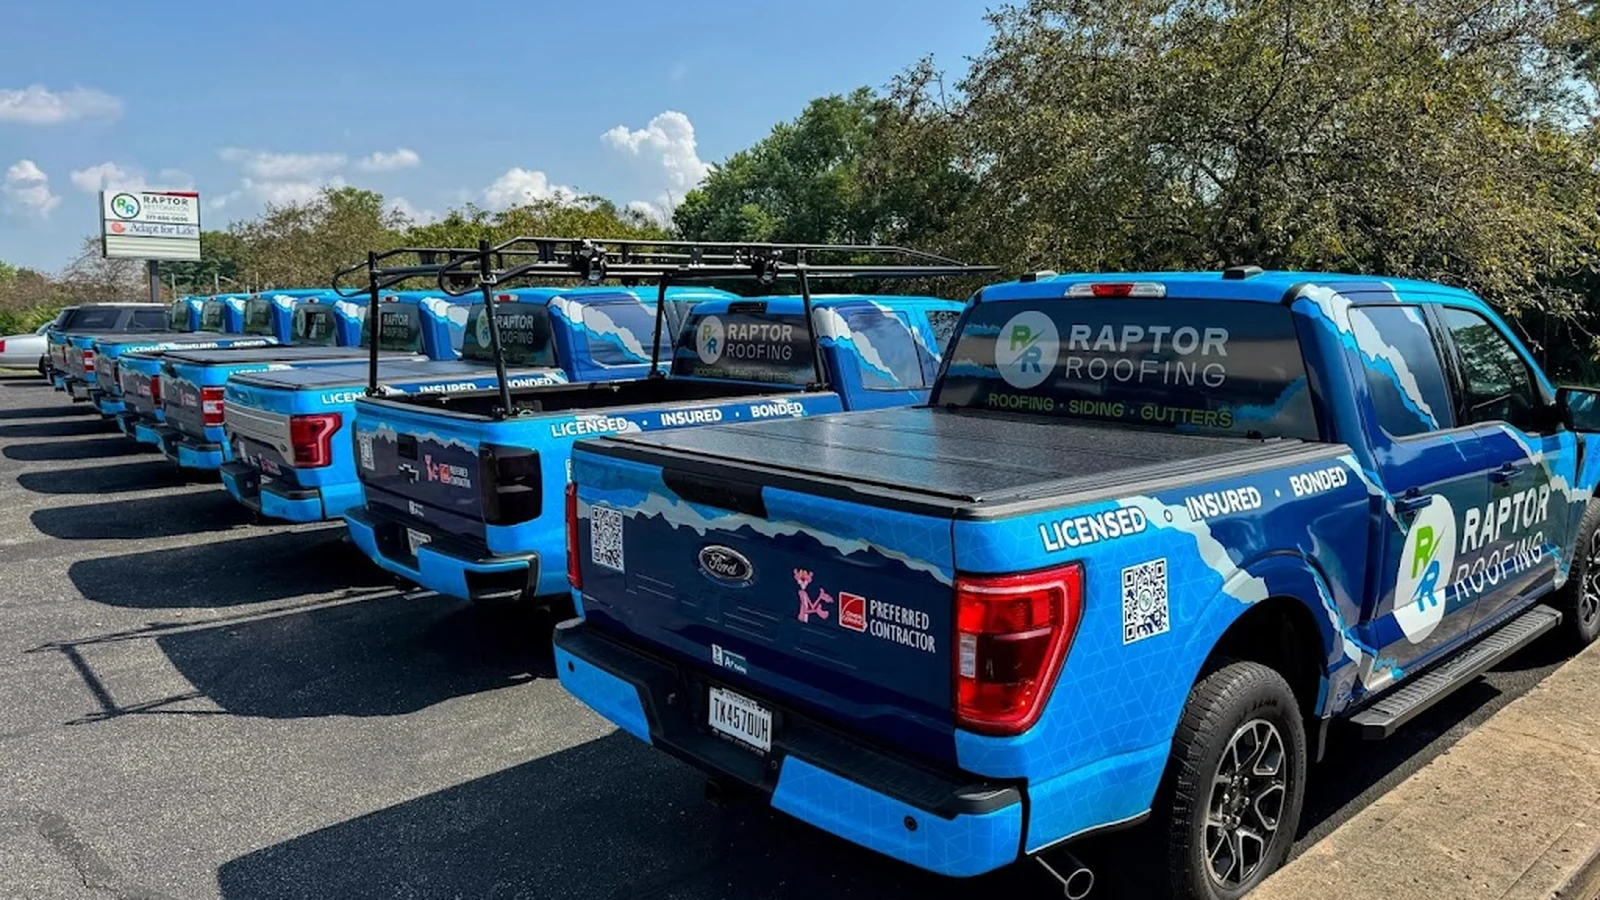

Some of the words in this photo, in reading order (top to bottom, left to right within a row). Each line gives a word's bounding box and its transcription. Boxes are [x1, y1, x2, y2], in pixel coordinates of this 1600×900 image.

[143, 195, 188, 206] RAPTOR
[130, 223, 159, 235] Adapt
[160, 224, 174, 234] for
[176, 226, 195, 236] Life
[382, 313, 409, 326] RAPTOR
[496, 314, 534, 330] RAPTOR
[727, 323, 793, 342] RAPTOR
[500, 330, 534, 344] OOFING
[1068, 324, 1229, 357] RAPTOR
[726, 343, 792, 360] ROOFING
[1065, 356, 1226, 388] ROOFING
[321, 391, 367, 405] LICEN
[988, 392, 1055, 412] ROOFING
[1069, 399, 1125, 418] SIDING
[1140, 405, 1233, 428] GUTTERS
[551, 417, 628, 437] LICENSED
[660, 408, 722, 426] INSURED
[751, 402, 803, 418] BONDED
[1039, 505, 1146, 552] LICENSED
[1185, 486, 1261, 522] INSURED
[1289, 466, 1348, 497] BONDED
[1461, 483, 1550, 554] RAPTOR
[705, 551, 738, 576] Ford
[1454, 531, 1543, 602] ROOFING
[870, 600, 930, 630] PREFERRED
[870, 619, 936, 653] CONTRACTOR
